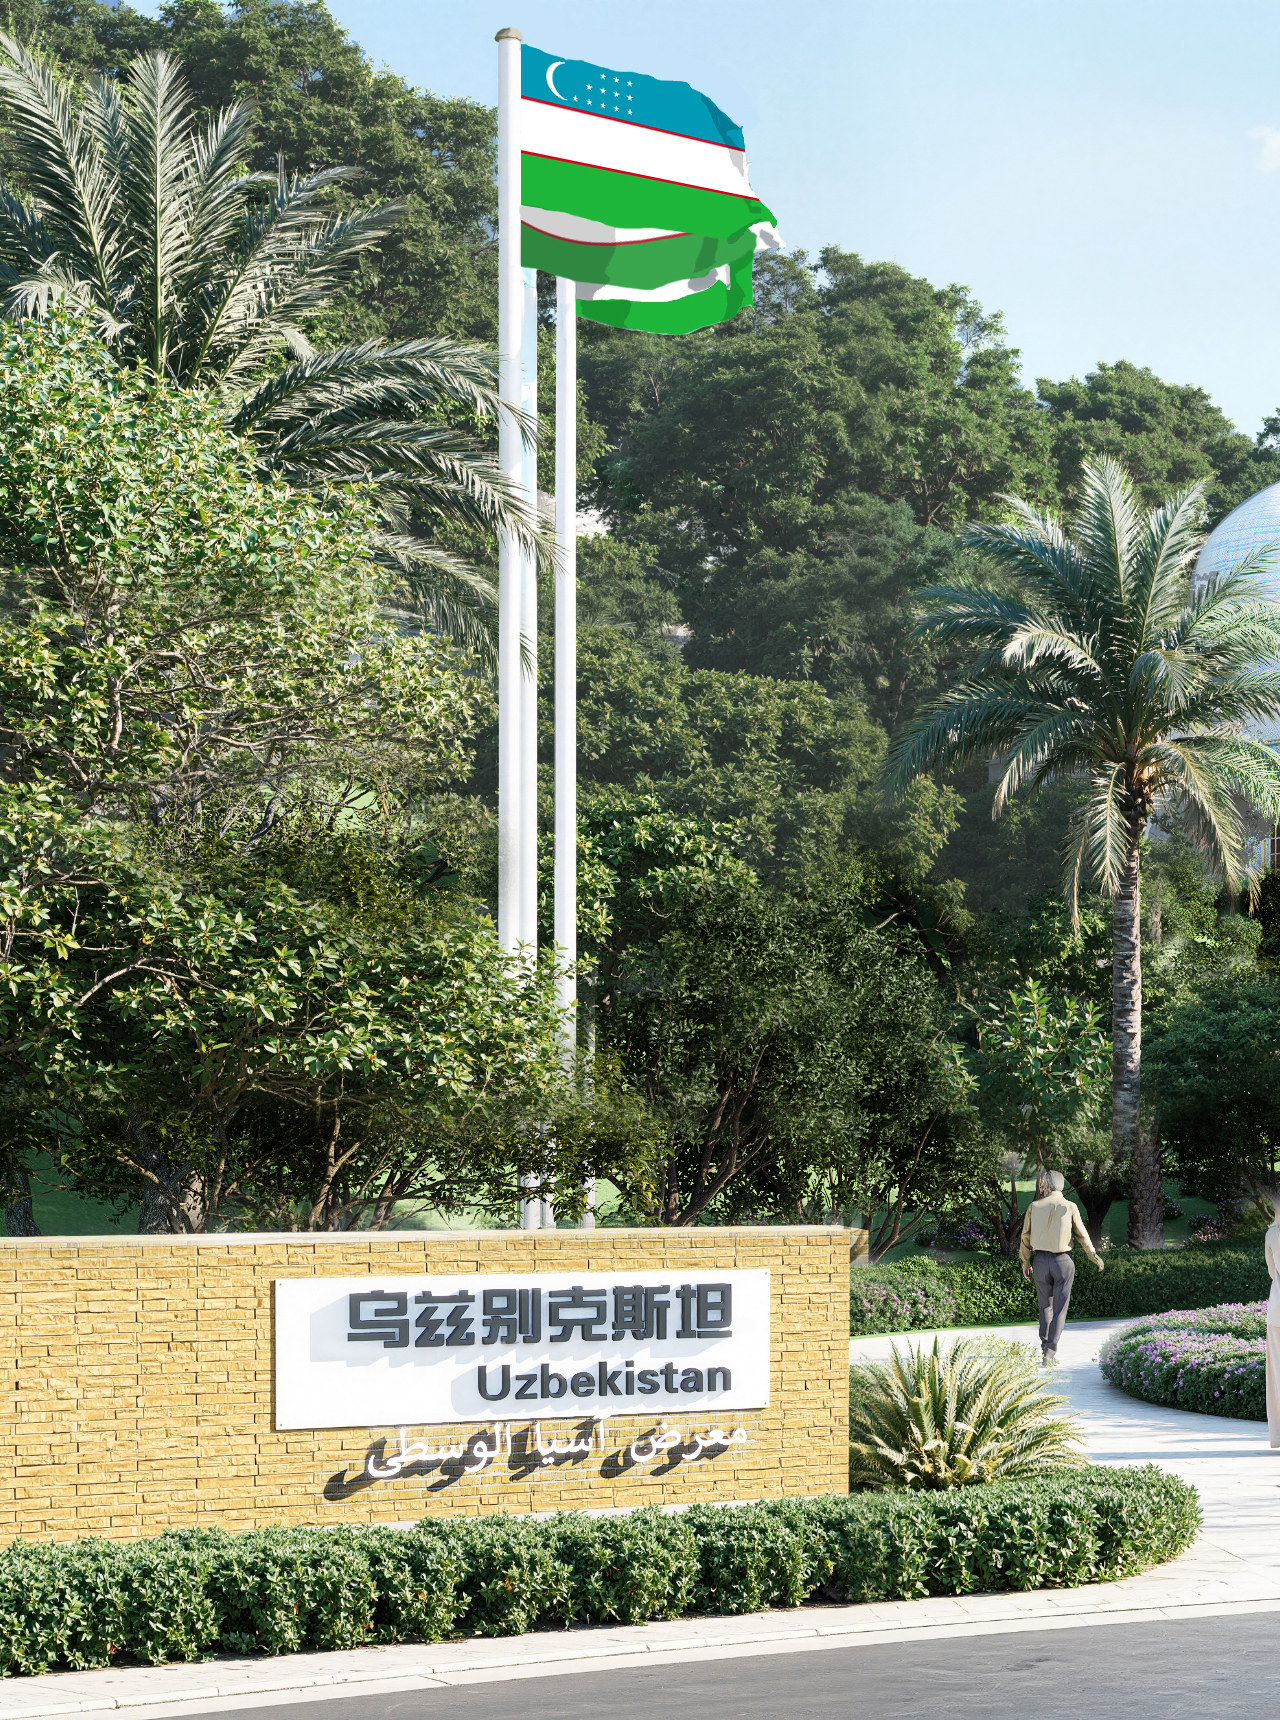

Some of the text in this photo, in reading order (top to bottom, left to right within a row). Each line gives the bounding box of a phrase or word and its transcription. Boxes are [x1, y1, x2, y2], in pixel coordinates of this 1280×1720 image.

[347, 1283, 733, 1348] 乌兹别克斯坦
[477, 1360, 732, 1401] Uzbekistan
[367, 1421, 512, 1478] الوسطى
[630, 1422, 748, 1461] معرض
